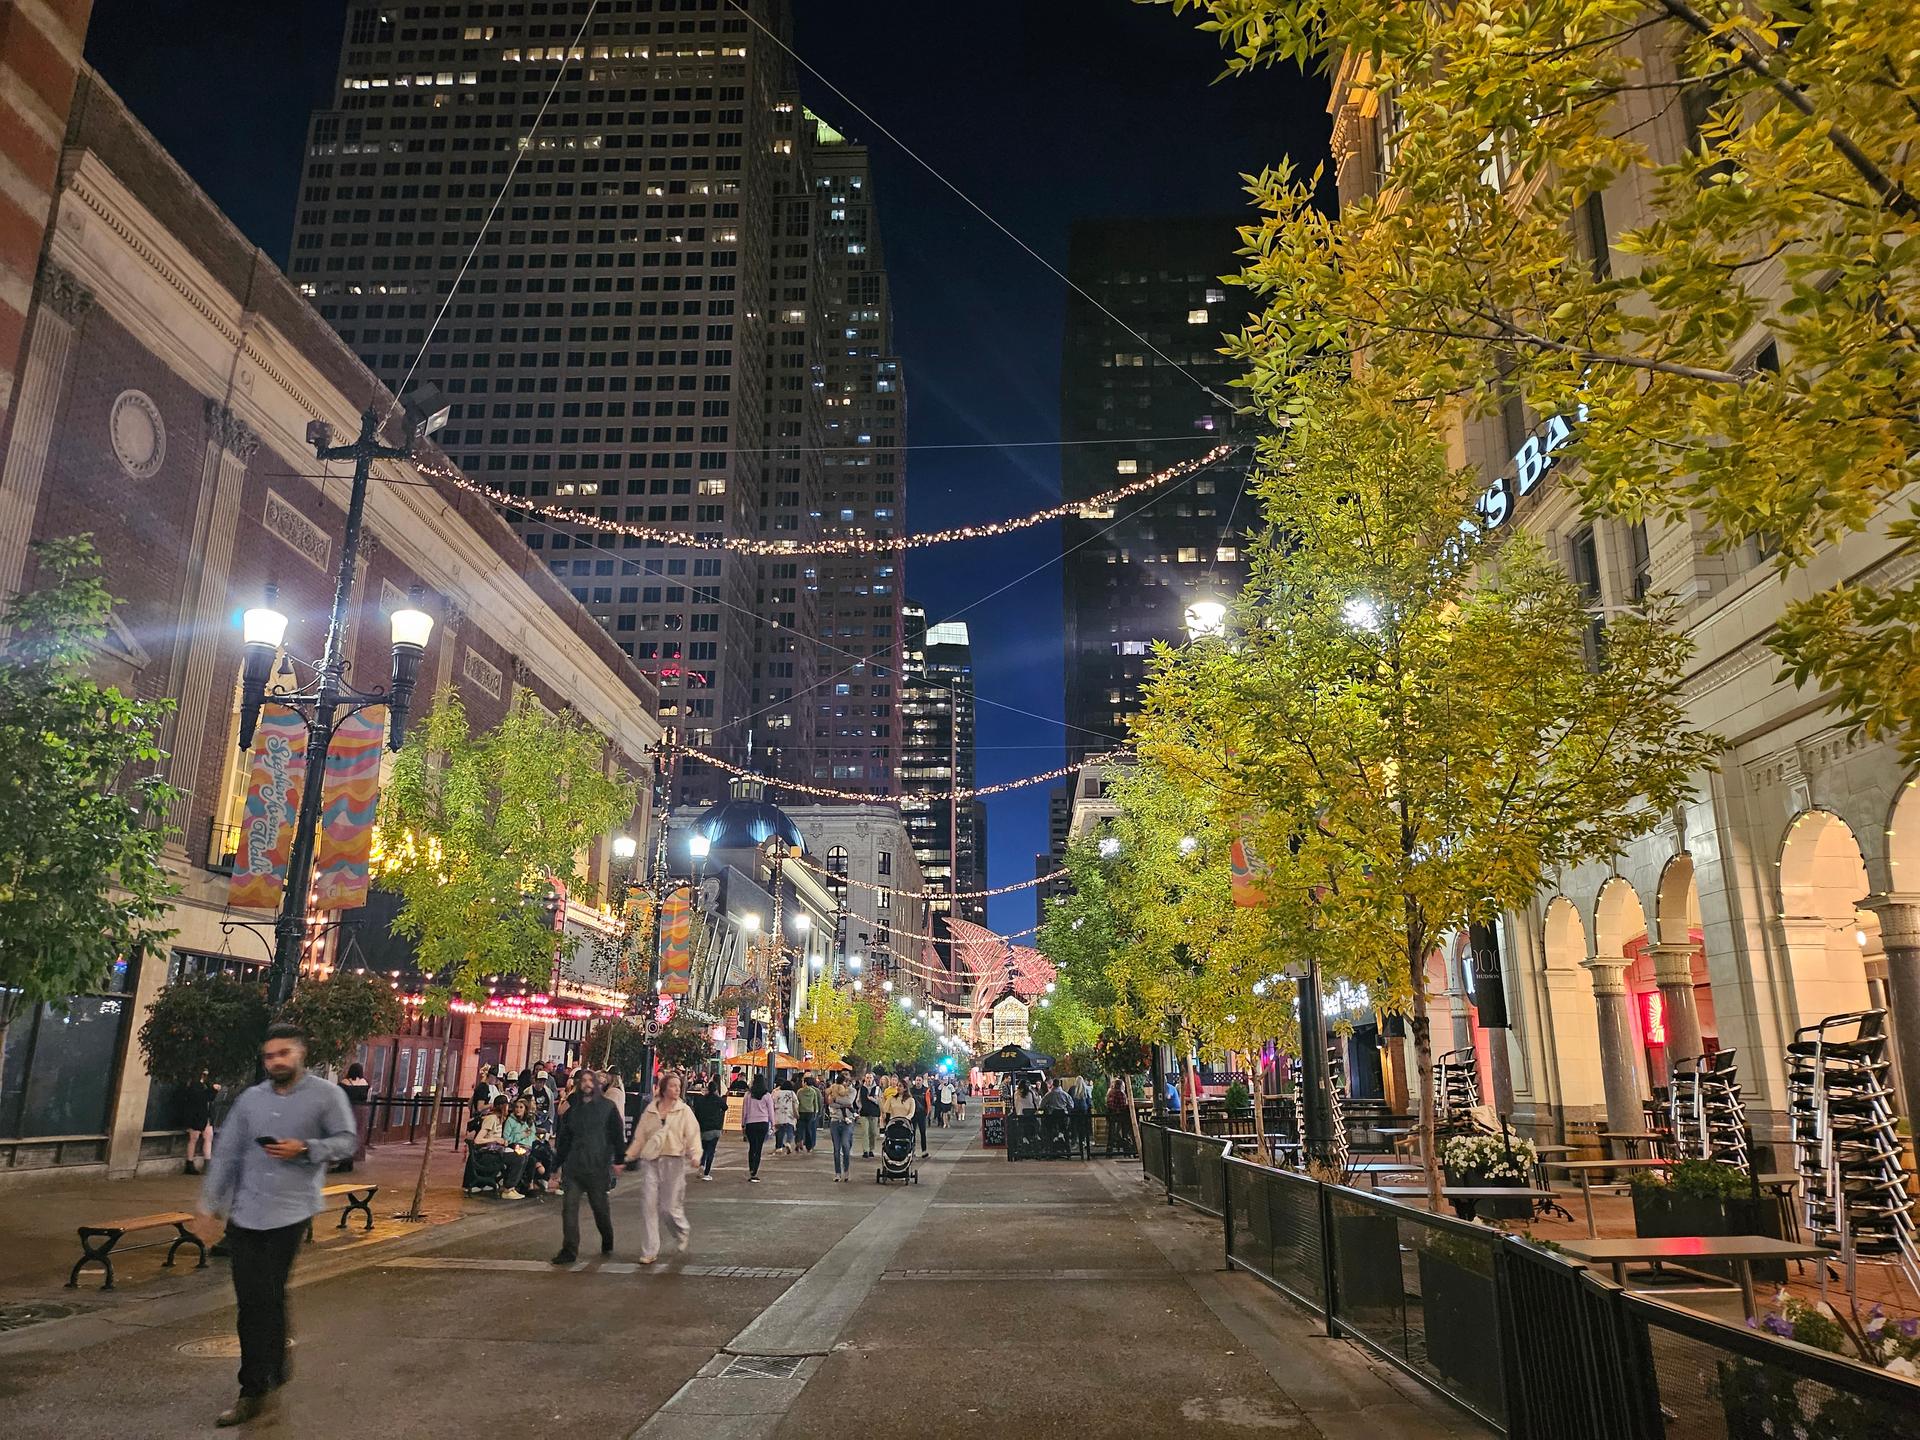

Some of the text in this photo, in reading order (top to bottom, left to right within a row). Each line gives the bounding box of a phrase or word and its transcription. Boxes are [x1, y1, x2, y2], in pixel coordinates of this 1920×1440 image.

[264, 735, 295, 803] Stephen
[248, 817, 273, 874] Walk
[259, 784, 287, 849] Avenue
